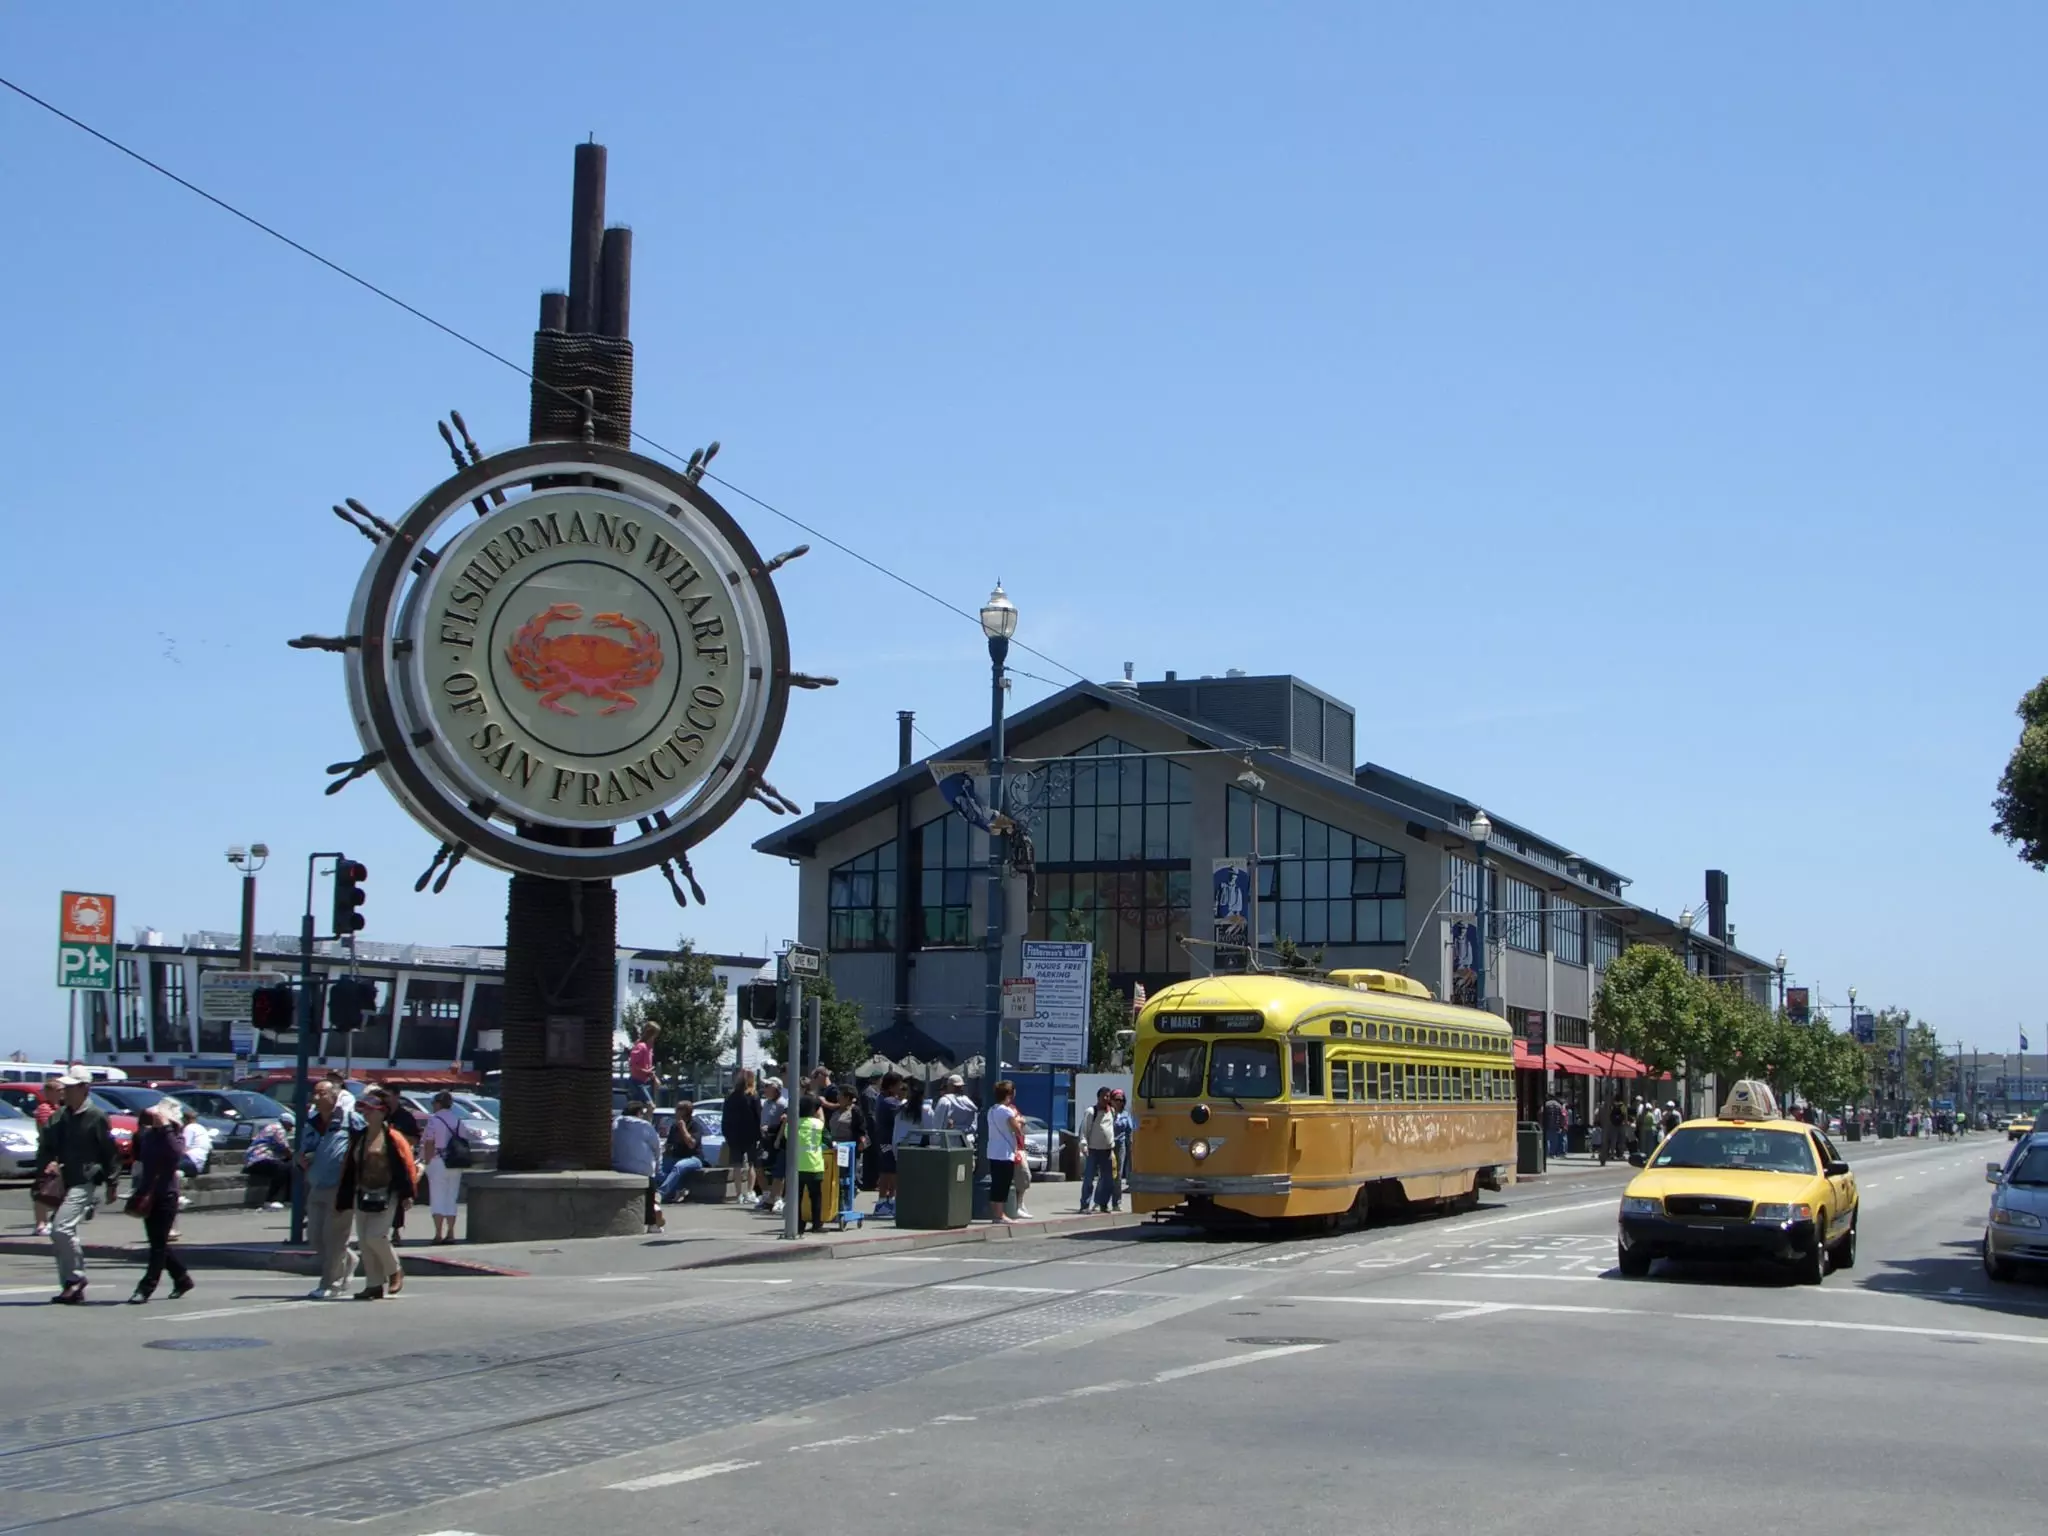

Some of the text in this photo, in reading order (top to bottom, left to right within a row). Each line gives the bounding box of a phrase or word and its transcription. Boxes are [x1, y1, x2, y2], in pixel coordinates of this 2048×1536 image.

[439, 509, 730, 668] FISHERMANS WHARF
[443, 671, 727, 808] OF SAN FRANCISCO
[1034, 962, 1061, 970] HOURS
[1063, 963, 1082, 971] FREE
[1036, 970, 1072, 978] PARKING
[1012, 995, 1026, 1003] ANY
[1011, 1003, 1028, 1012] TIME
[1170, 1016, 1202, 1029] MARKET
